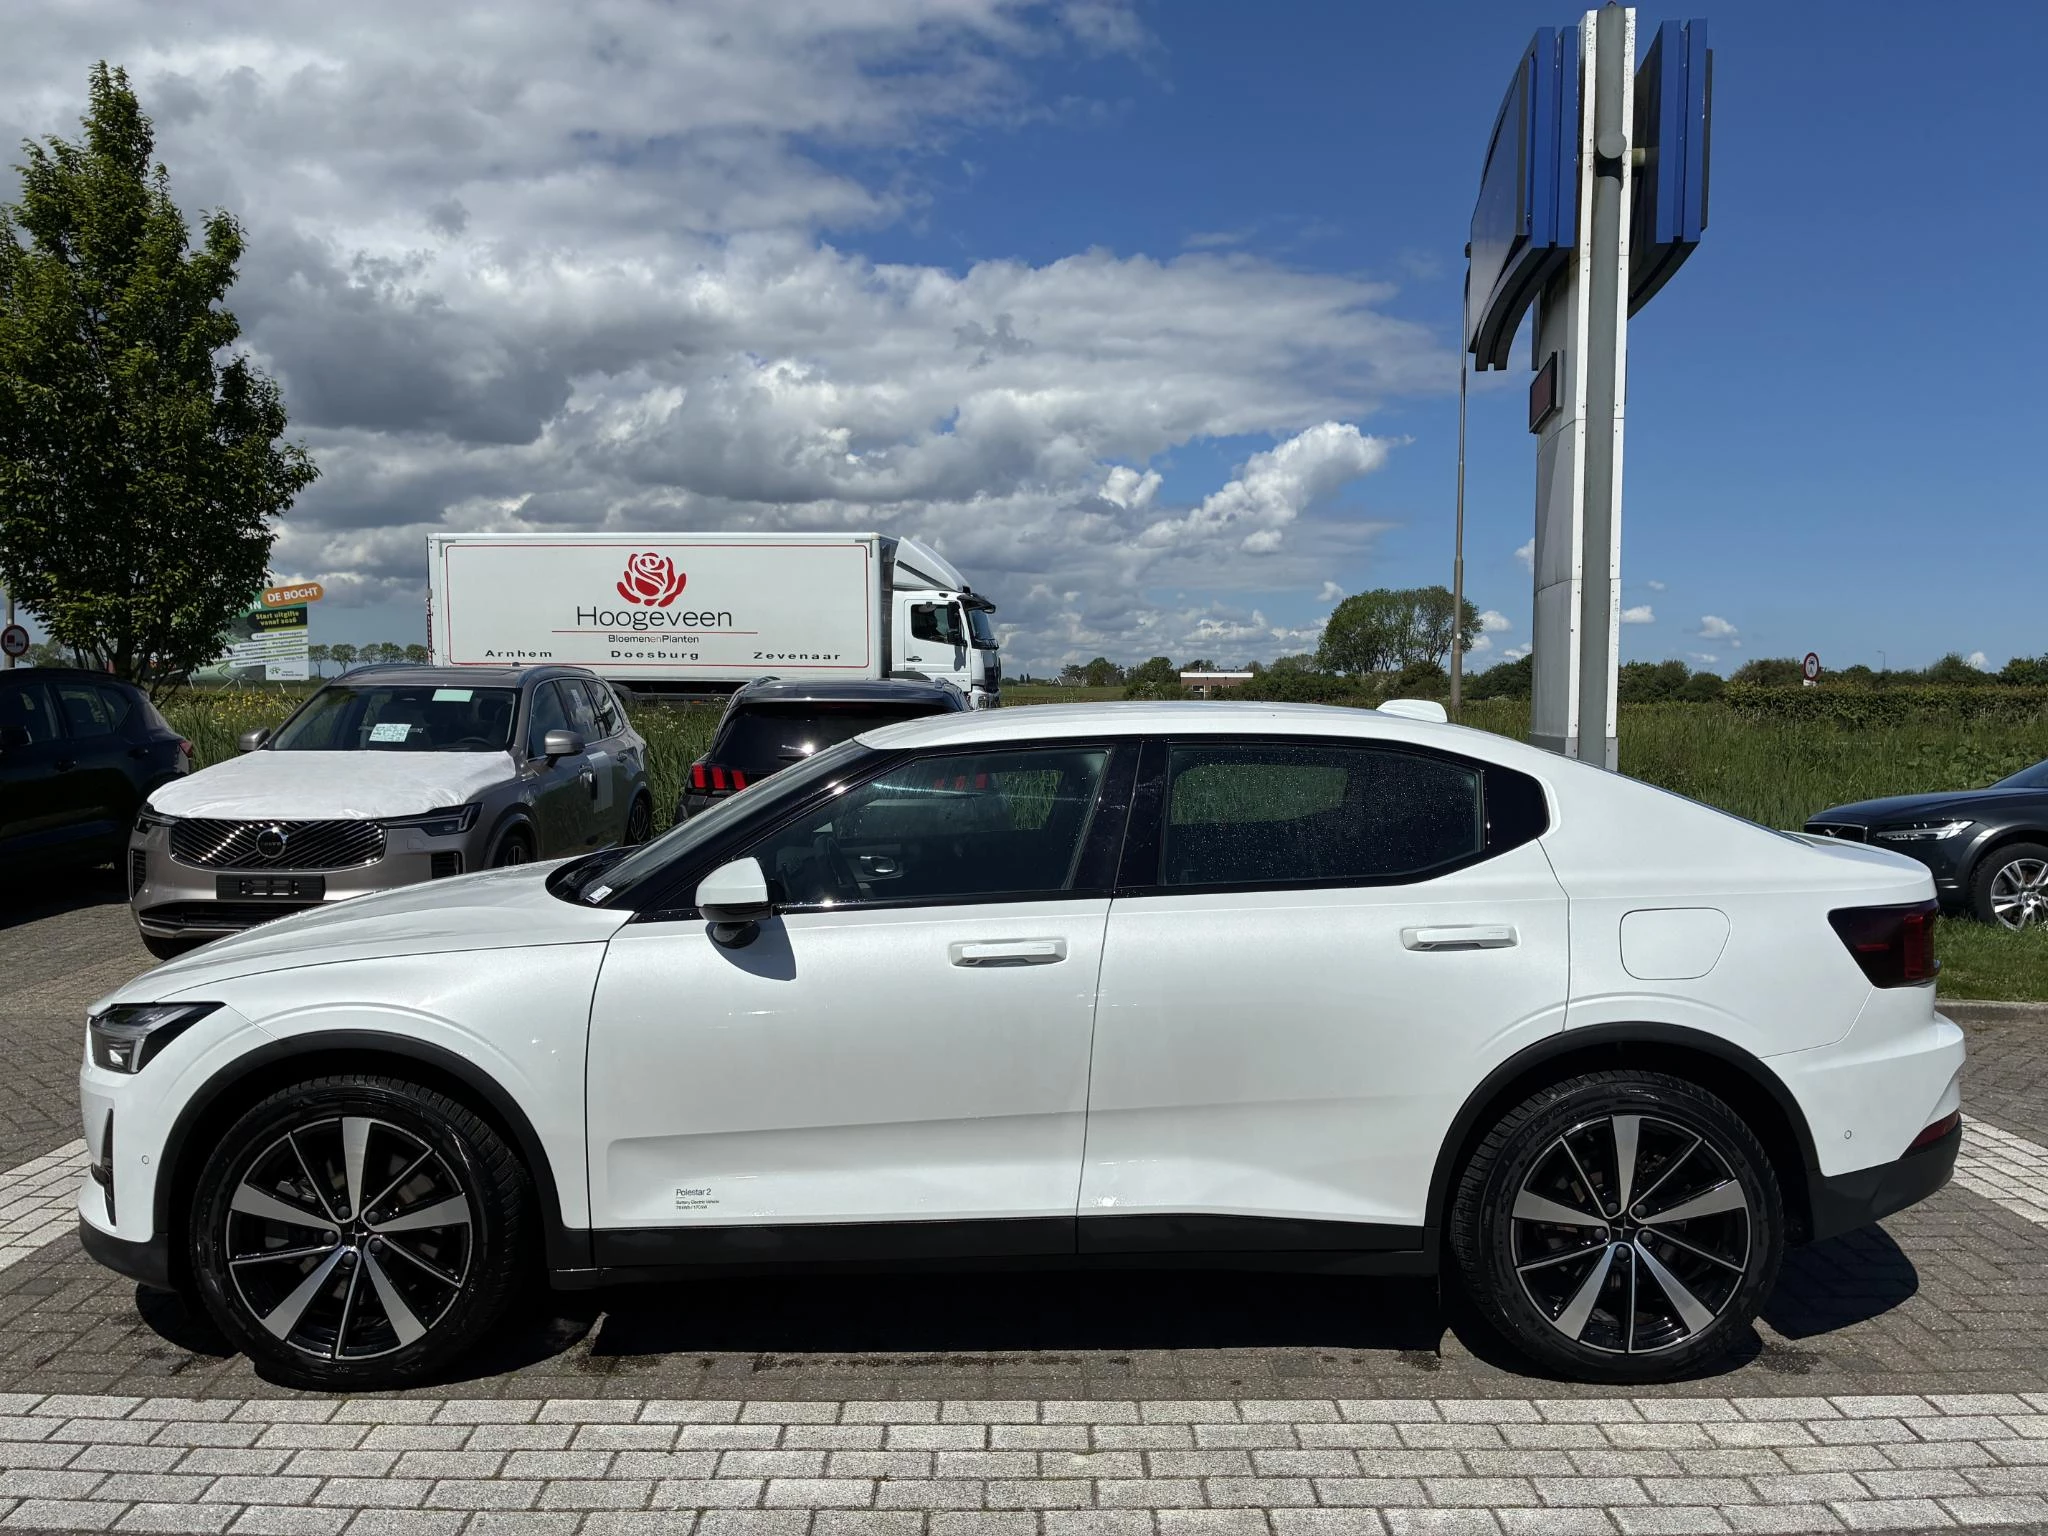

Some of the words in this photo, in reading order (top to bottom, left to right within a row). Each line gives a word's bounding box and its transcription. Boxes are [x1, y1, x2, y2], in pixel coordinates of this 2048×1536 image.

[267, 592, 281, 602] DE
[283, 587, 318, 600] BOCHT
[255, 612, 273, 620] Start
[577, 606, 732, 631] Hoogeveen
[611, 650, 699, 660] Doesburg
[753, 651, 841, 660] Zevenaar
[676, 1188, 705, 1196] Polestar
